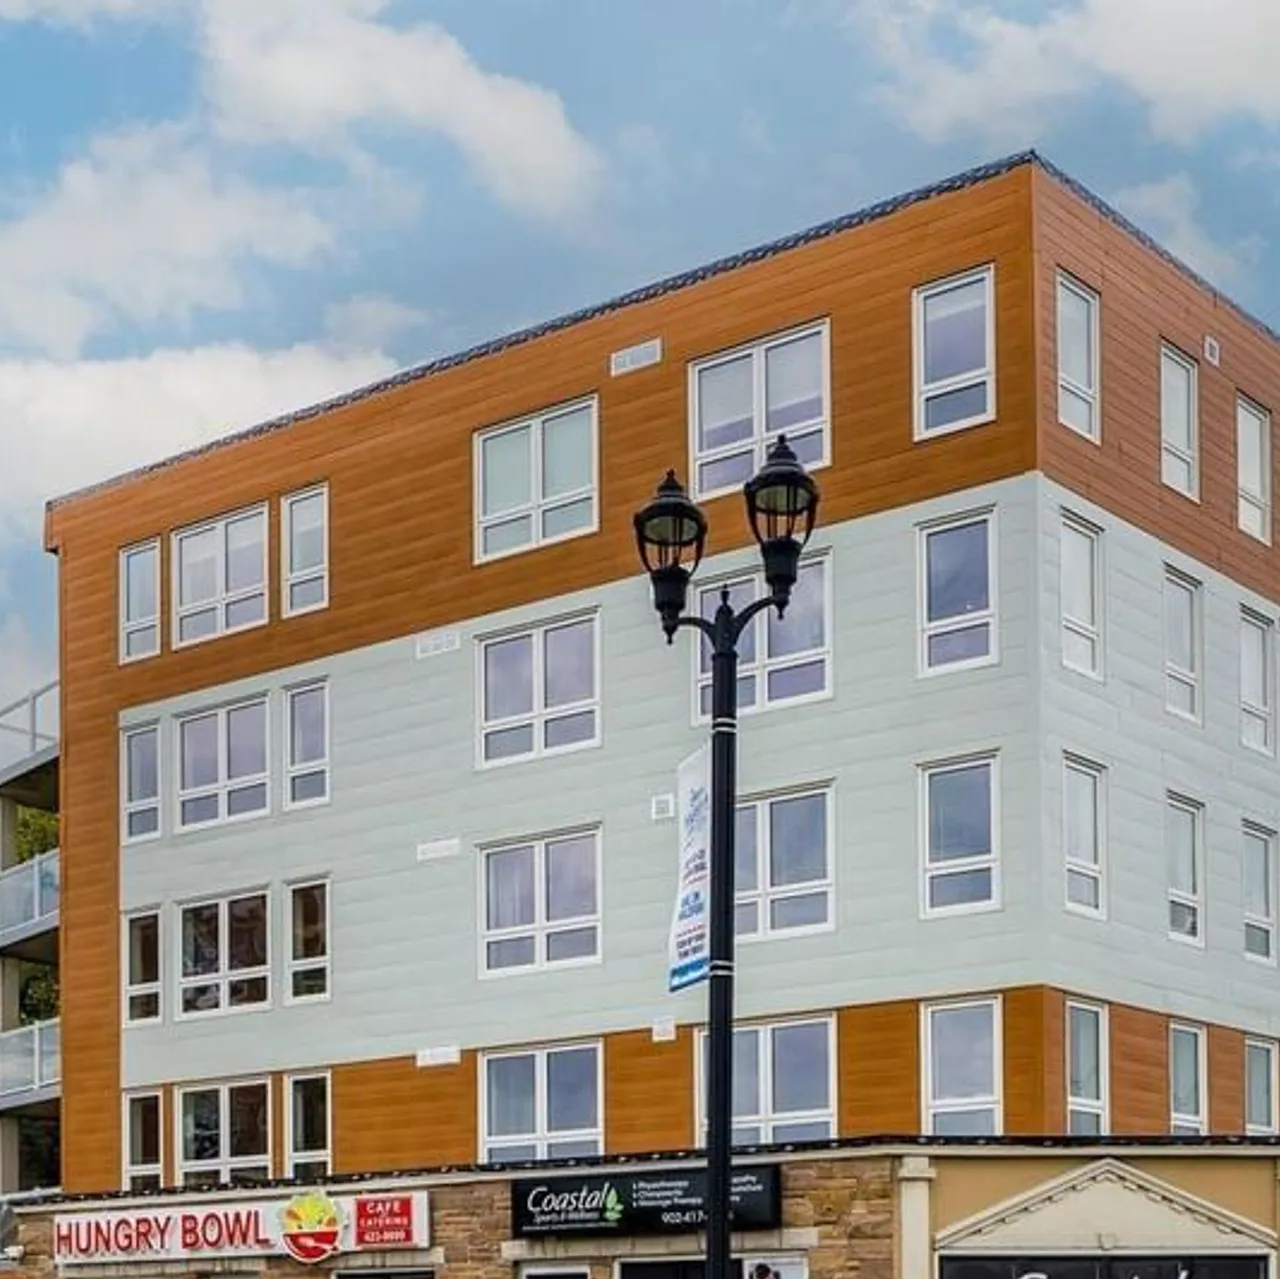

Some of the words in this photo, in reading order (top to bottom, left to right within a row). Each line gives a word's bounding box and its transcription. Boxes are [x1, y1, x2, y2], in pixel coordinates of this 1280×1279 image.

[365, 1201, 402, 1214] CAFE
[527, 1181, 610, 1212] Coastal
[54, 1216, 172, 1256] HUNGRY
[180, 1209, 271, 1249] BOWL
